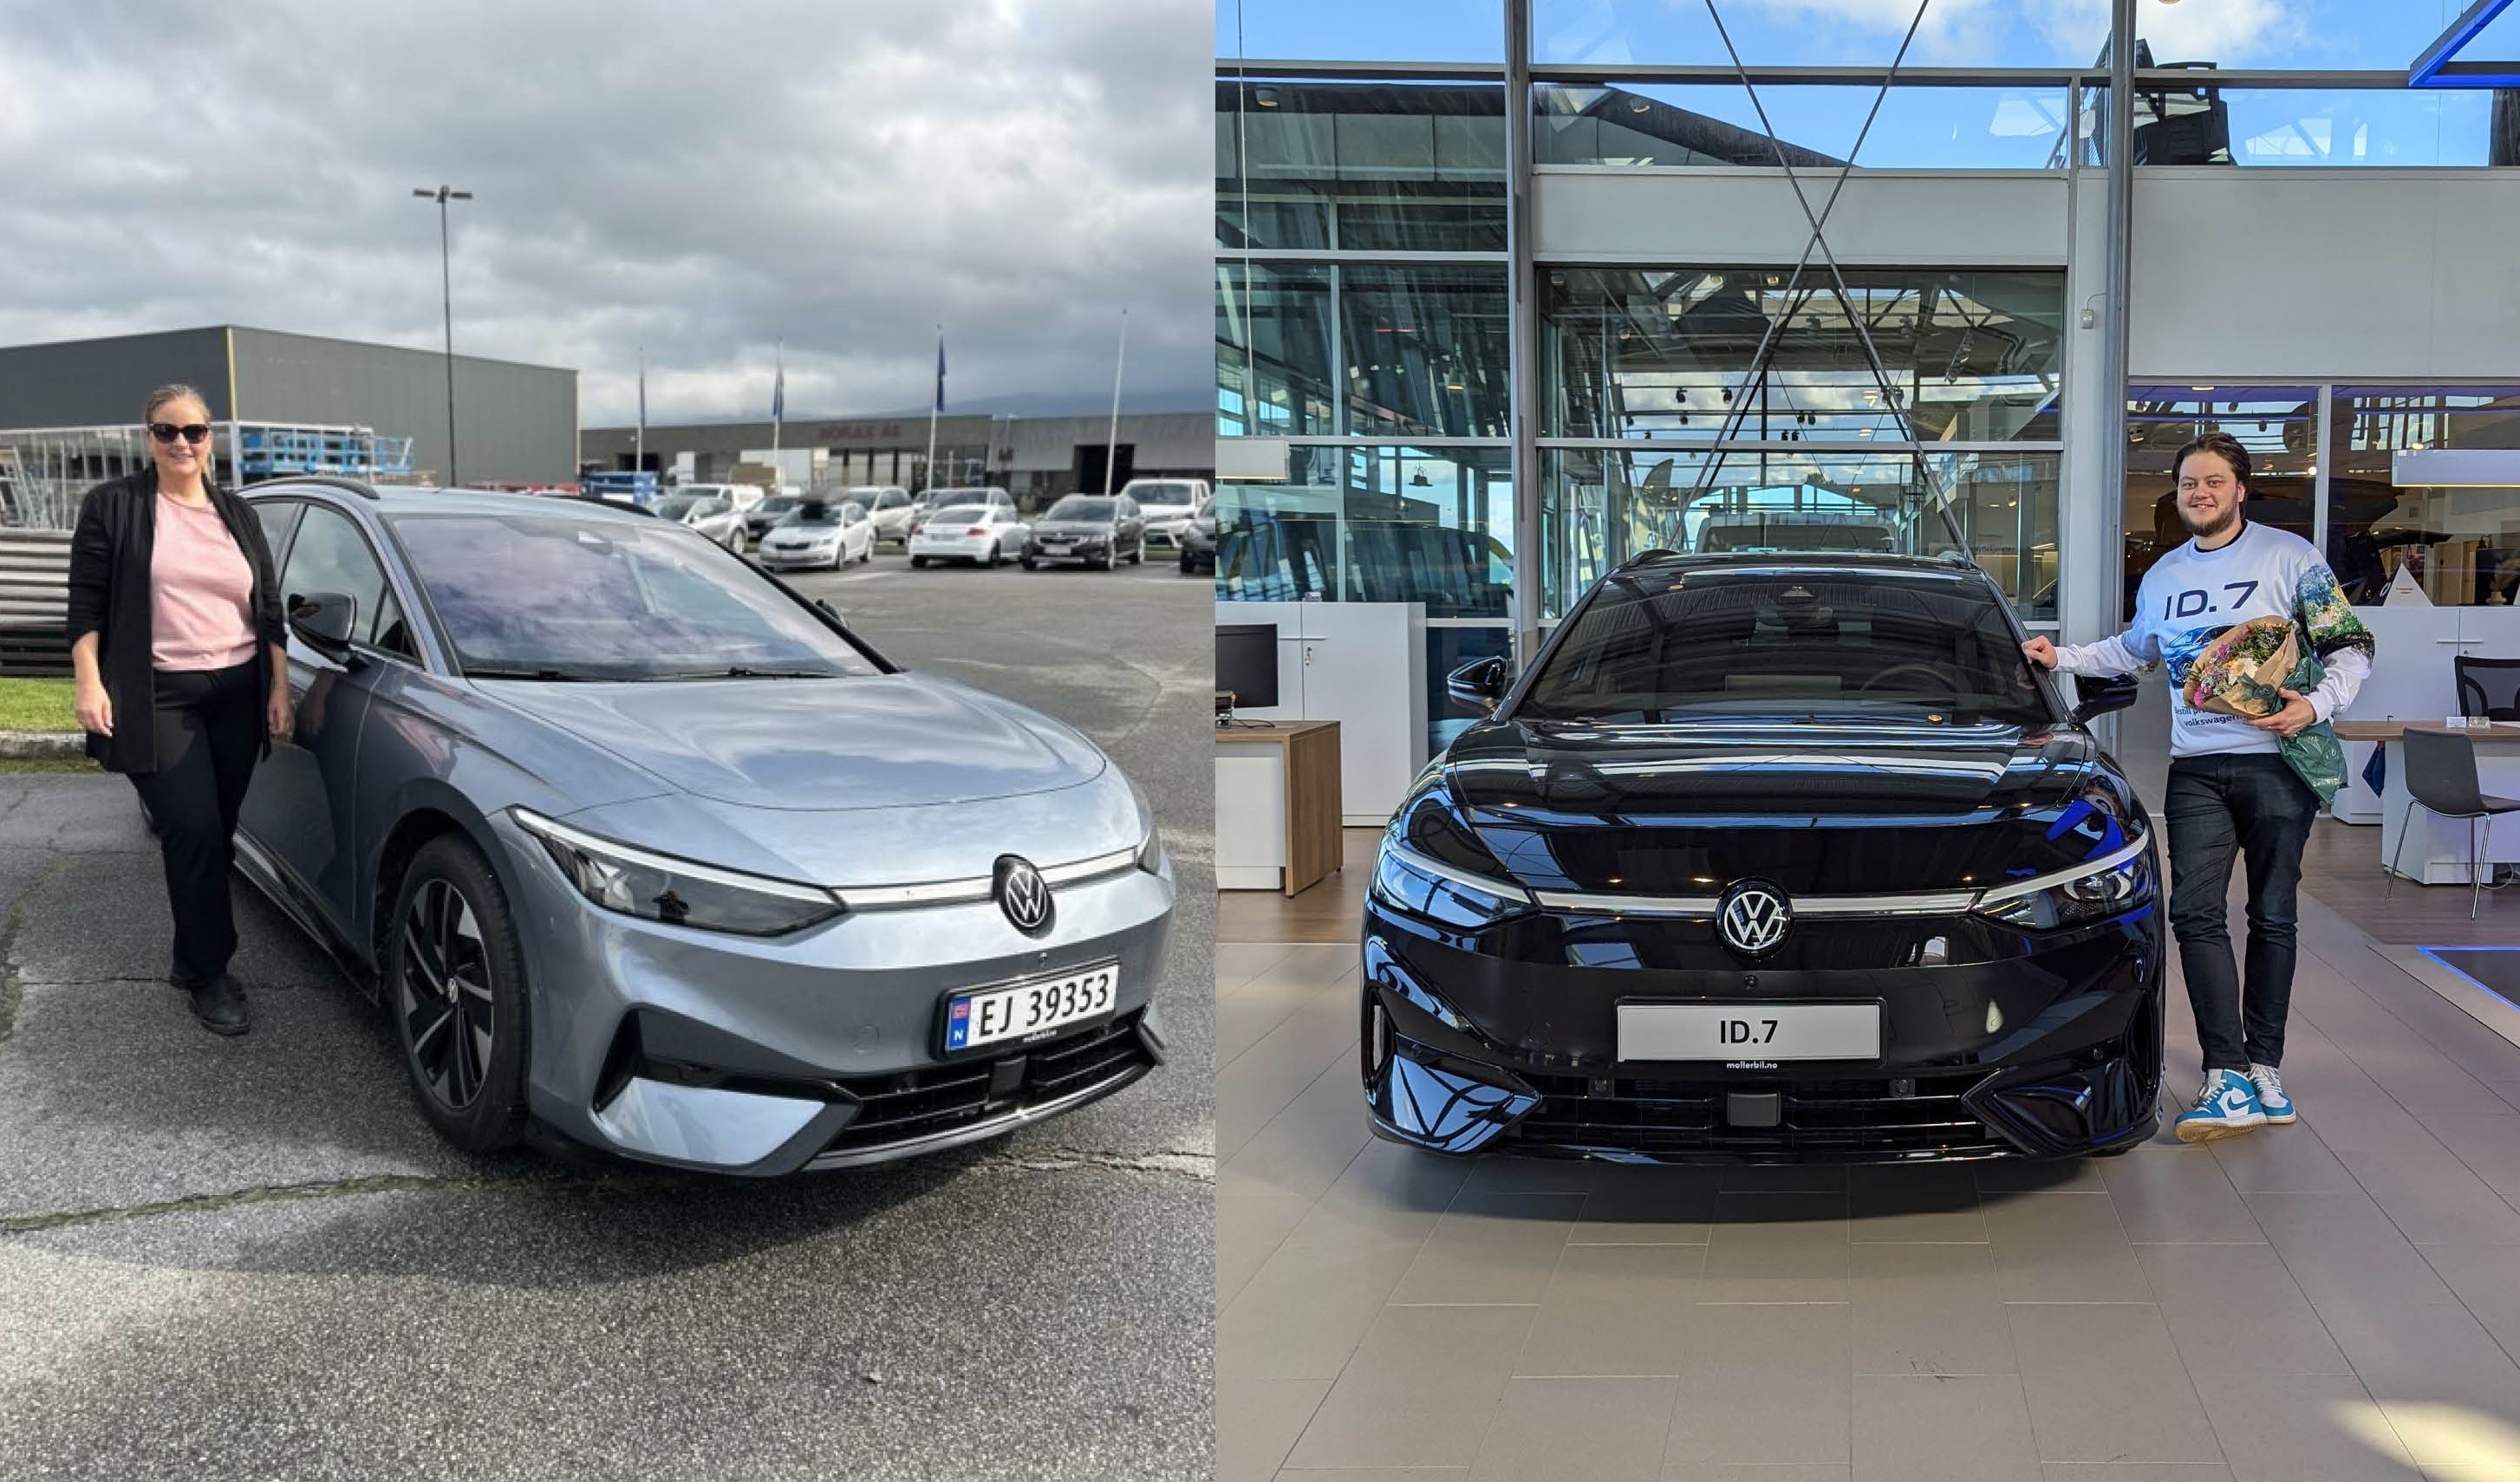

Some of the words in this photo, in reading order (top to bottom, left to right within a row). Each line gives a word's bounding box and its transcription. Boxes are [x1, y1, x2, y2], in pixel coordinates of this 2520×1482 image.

[2164, 580, 2258, 621] ID.7
[2184, 715, 2243, 726] volkswagen.
[980, 997, 1013, 1036] EJ
[1026, 974, 1109, 1026] 39353
[954, 1030, 964, 1041] N
[1720, 1019, 1778, 1044] ID.7
